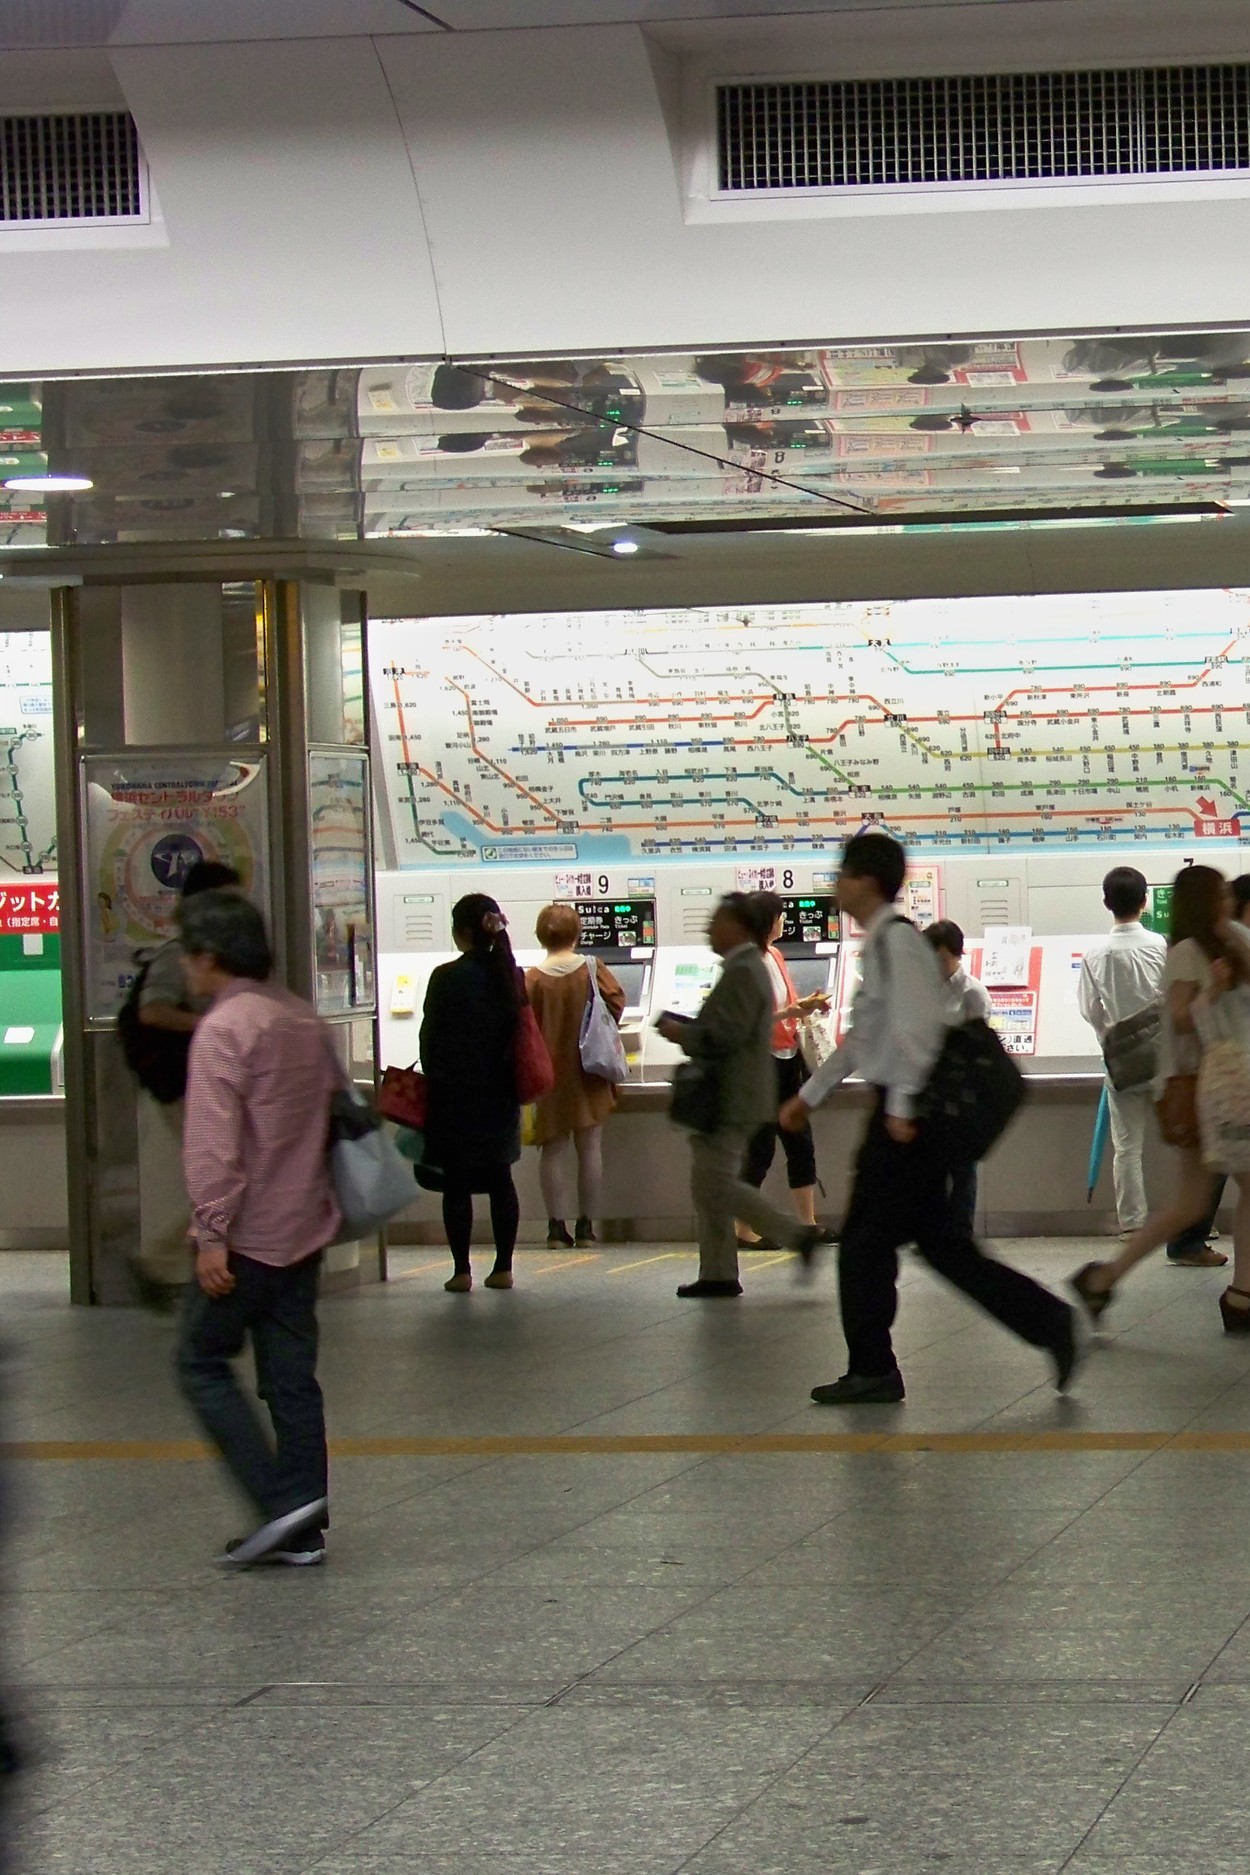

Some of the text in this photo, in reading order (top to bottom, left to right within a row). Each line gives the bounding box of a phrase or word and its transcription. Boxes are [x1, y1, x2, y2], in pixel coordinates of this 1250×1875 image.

[1201, 822, 1232, 835] 横浜
[598, 875, 609, 894] 9
[783, 870, 794, 889] 8
[578, 905, 610, 913] Suica
[614, 915, 639, 925] きっぷ
[799, 911, 823, 920] きっぷ
[580, 932, 612, 941] チャージ
